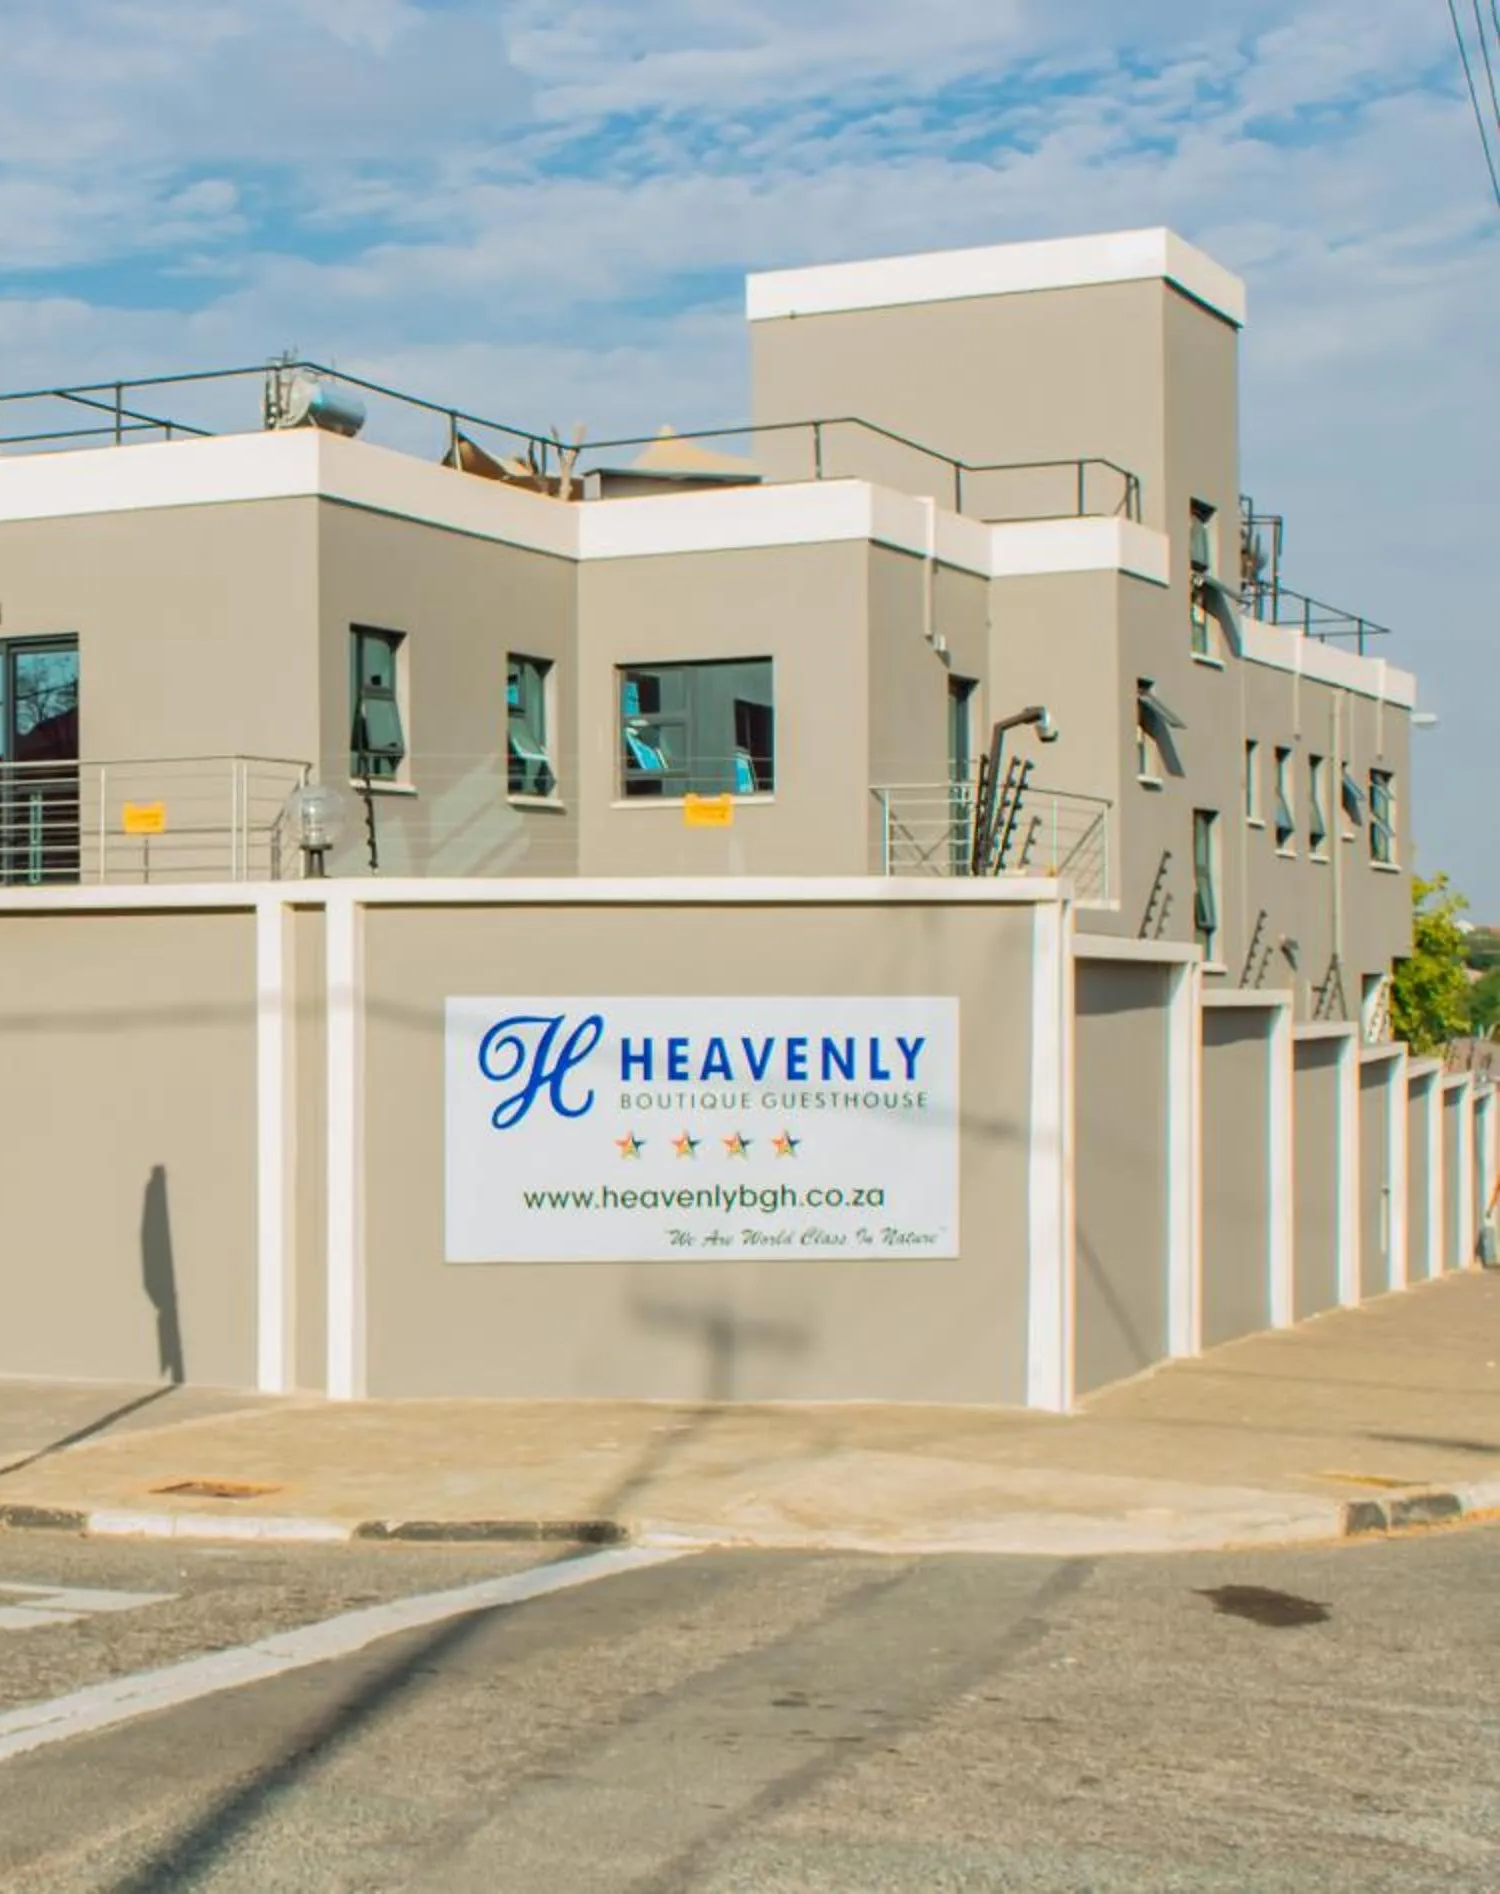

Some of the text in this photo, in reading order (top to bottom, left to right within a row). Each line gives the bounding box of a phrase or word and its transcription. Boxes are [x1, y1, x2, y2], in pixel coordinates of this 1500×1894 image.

[620, 1036, 926, 1082] HEAVENLY
[619, 1089, 928, 1112] BOUTIQUE GUESTHOUSE
[522, 1183, 886, 1214] www.heavenlybgh.co.za
[700, 1228, 734, 1247] Are
[740, 1226, 793, 1246] World
[799, 1226, 847, 1246] Class
[855, 1227, 874, 1244] In
